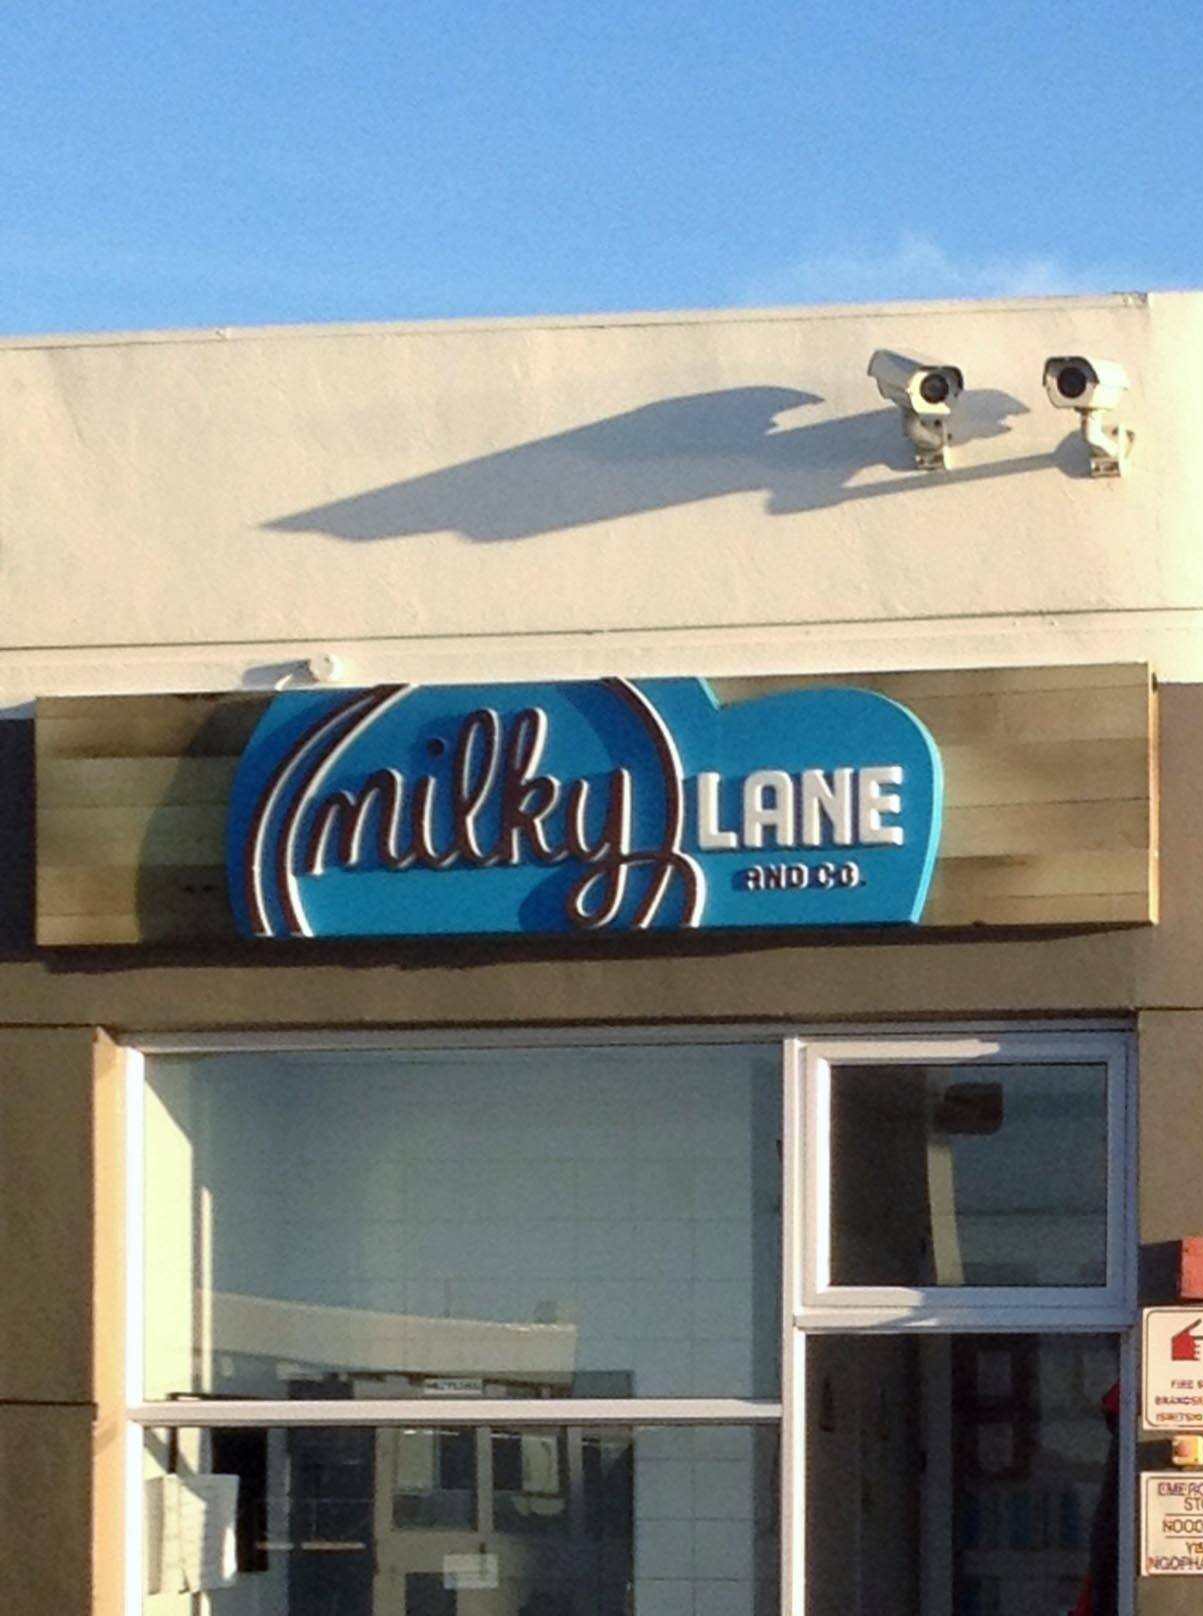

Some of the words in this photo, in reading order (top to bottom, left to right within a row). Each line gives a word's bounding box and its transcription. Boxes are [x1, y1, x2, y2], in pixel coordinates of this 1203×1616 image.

[308, 707, 650, 928] milky
[697, 766, 904, 849] LANE
[746, 863, 809, 890] AND
[1170, 1379, 1194, 1390] FIRE
